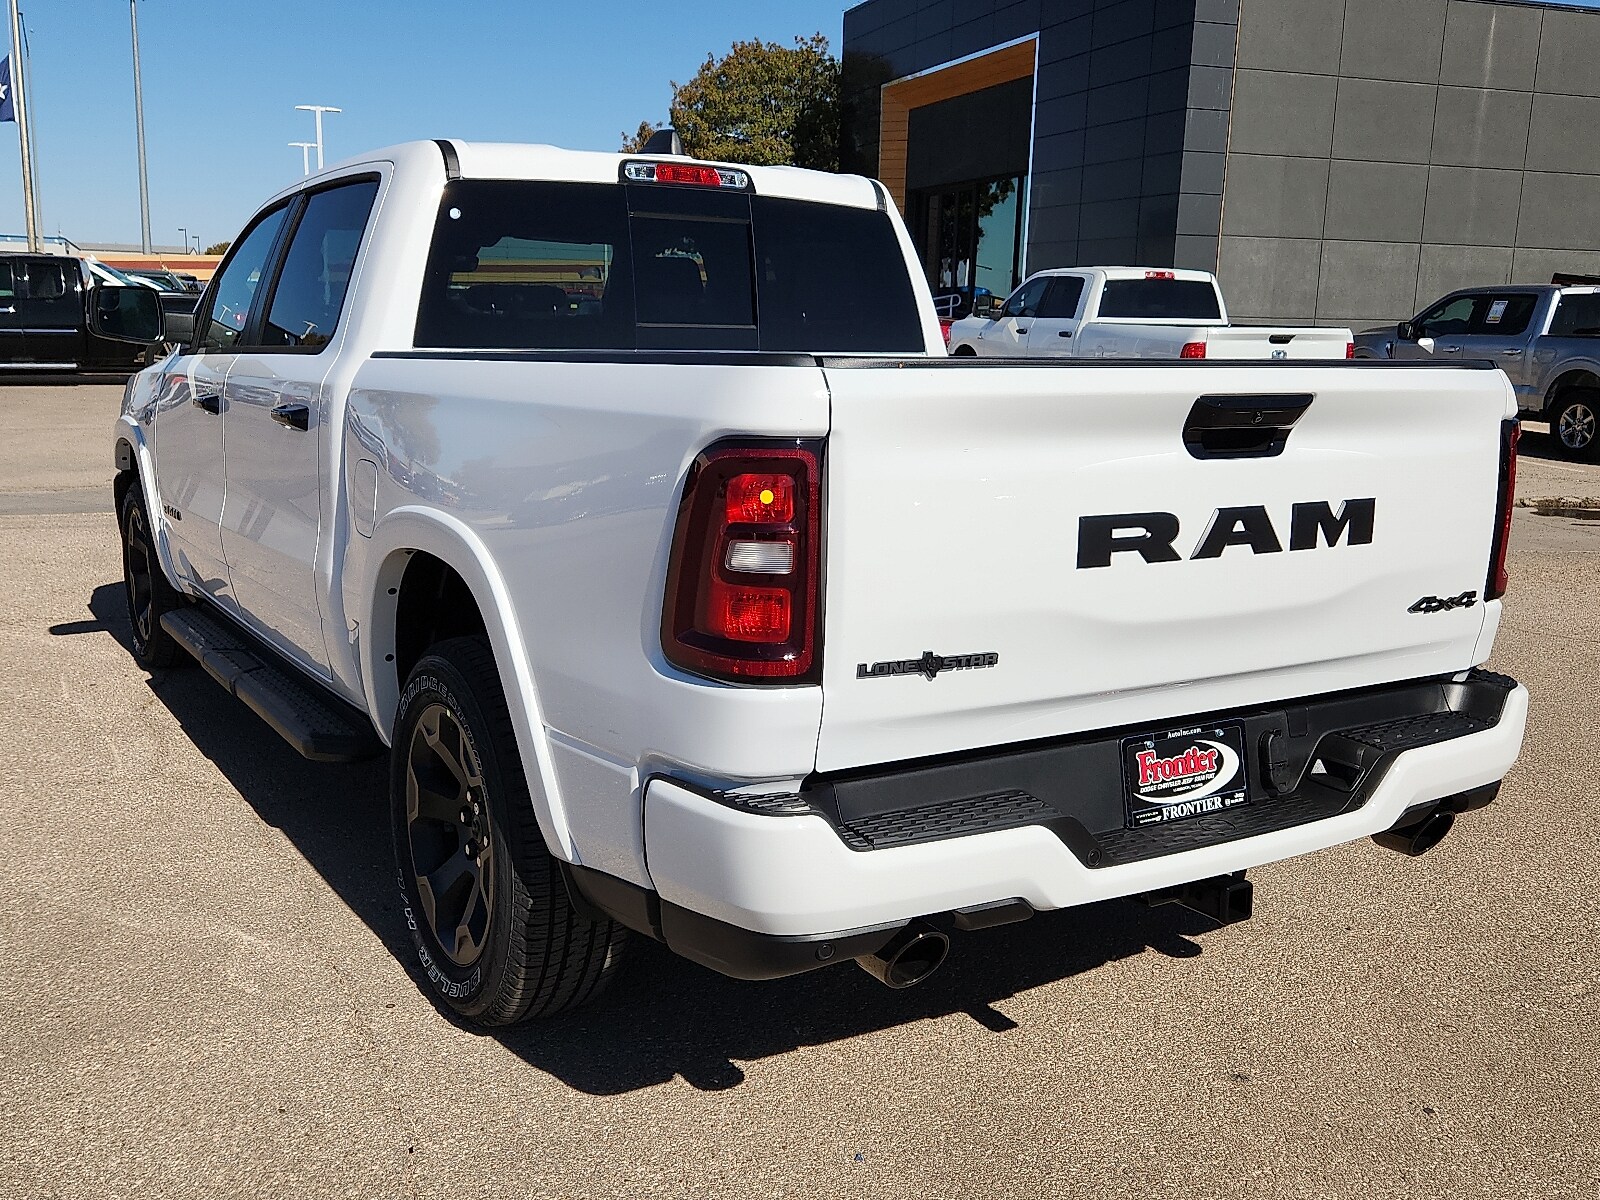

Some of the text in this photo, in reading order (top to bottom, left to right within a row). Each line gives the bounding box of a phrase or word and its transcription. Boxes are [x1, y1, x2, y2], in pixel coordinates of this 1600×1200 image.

[1076, 497, 1376, 569] RAM
[856, 652, 999, 679] LONE STAR
[1136, 746, 1218, 785] Frontier
[1161, 796, 1223, 820] FRONTIER
[418, 945, 481, 998] DUELER
